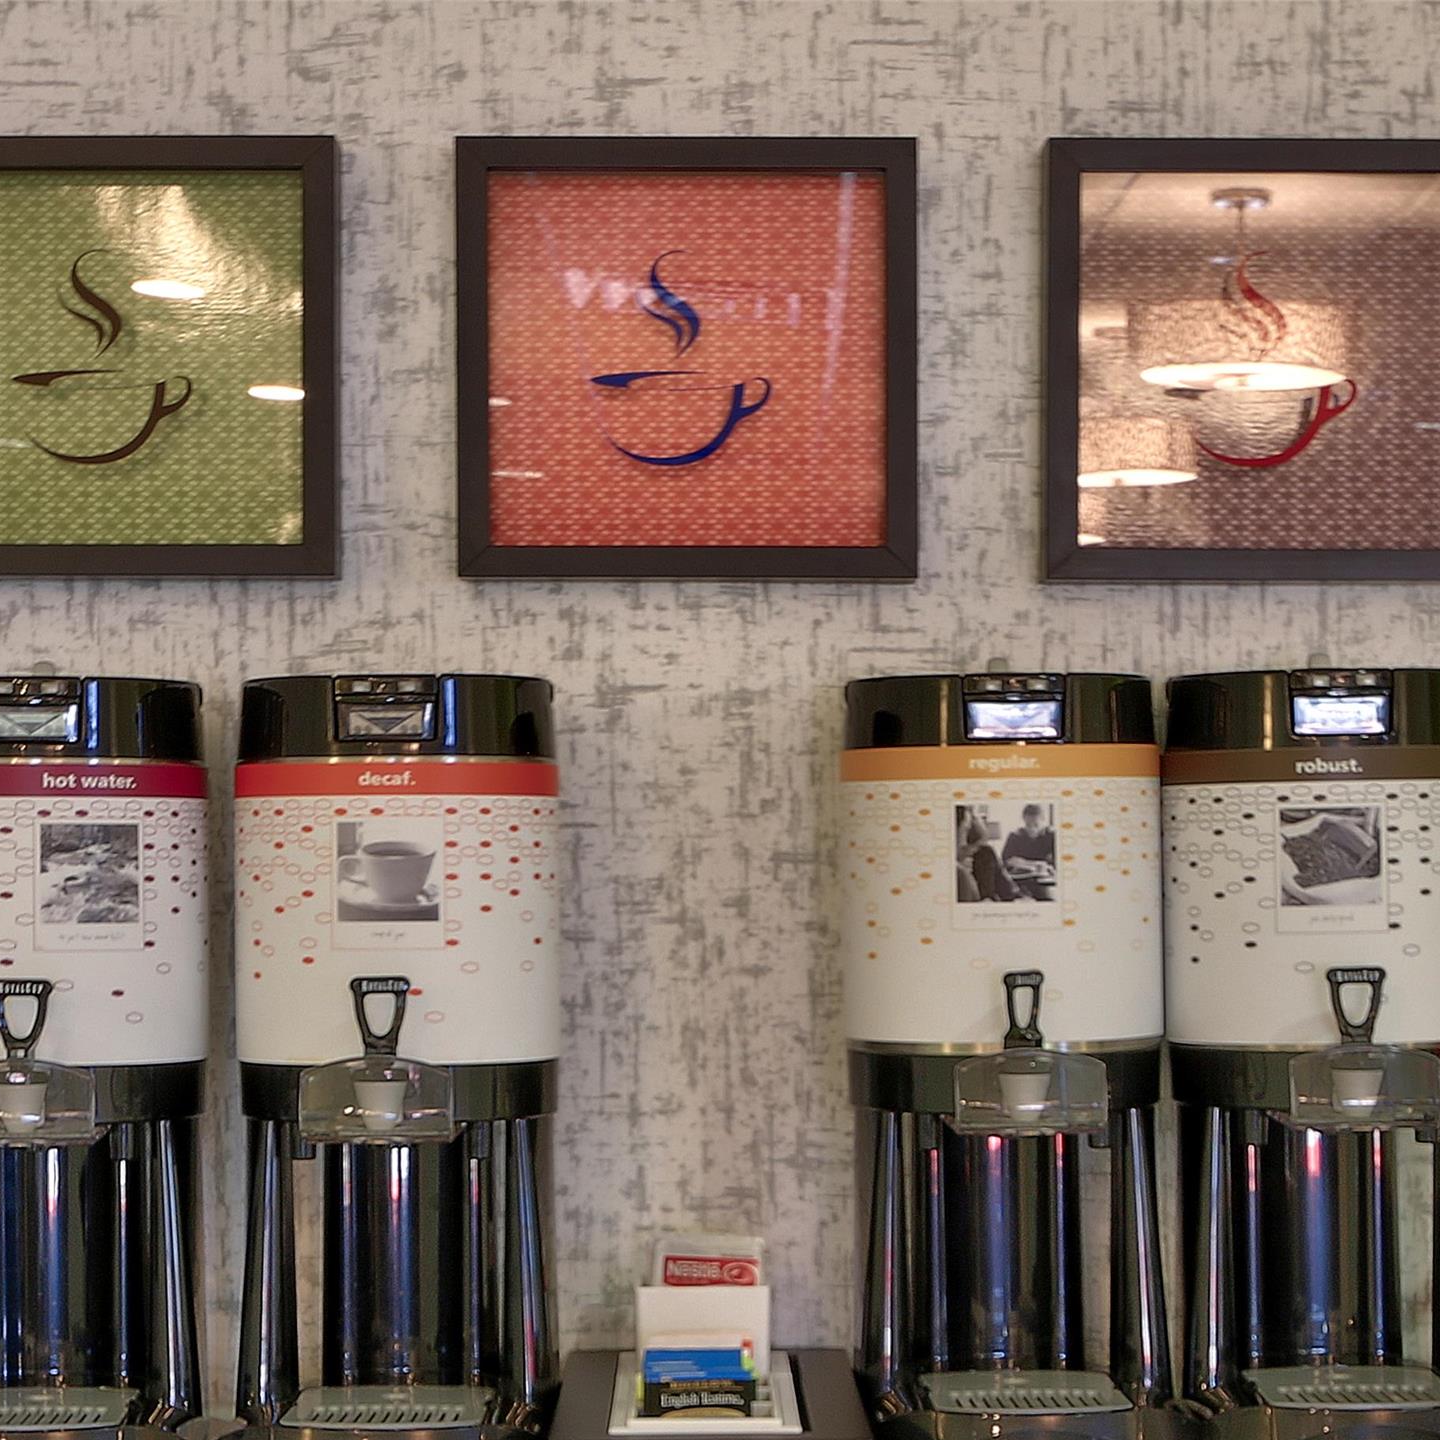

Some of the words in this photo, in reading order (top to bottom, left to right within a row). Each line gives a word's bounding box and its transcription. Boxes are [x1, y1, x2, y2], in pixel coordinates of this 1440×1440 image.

[1295, 757, 1363, 774] robust.
[42, 772, 77, 789] hot
[80, 774, 137, 789] water.
[358, 770, 416, 786] decaf.
